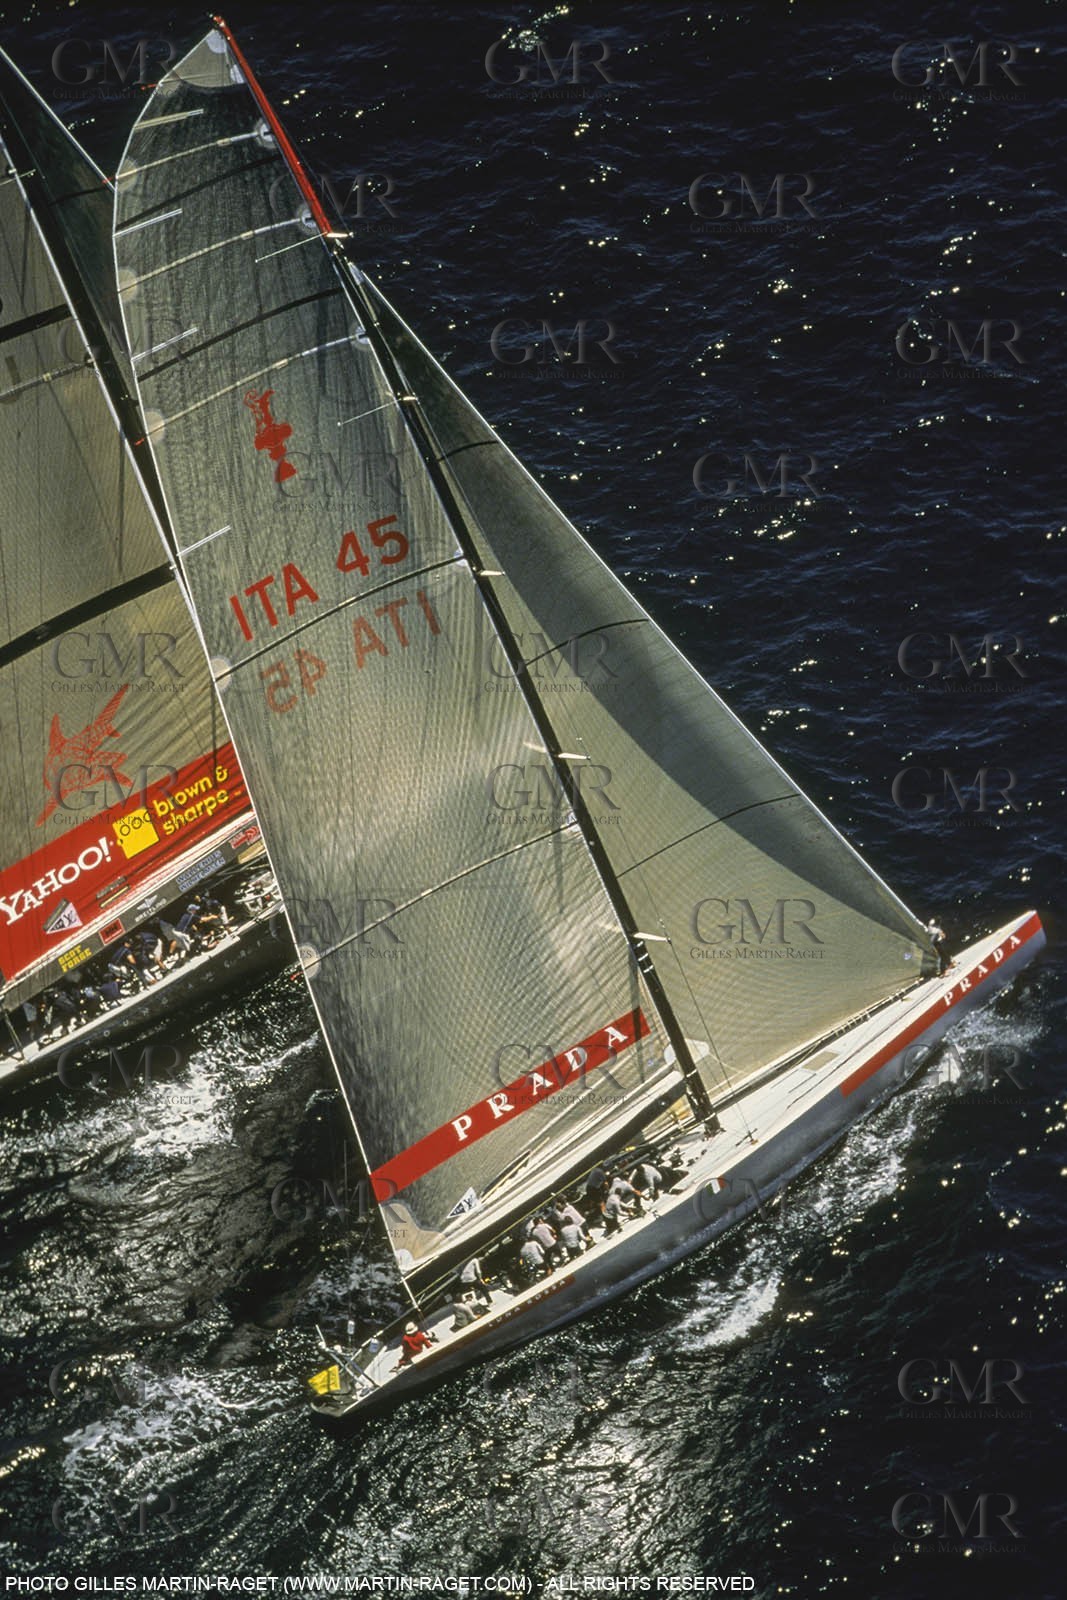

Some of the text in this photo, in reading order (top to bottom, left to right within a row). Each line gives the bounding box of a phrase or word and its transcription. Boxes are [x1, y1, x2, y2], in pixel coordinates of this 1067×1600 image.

[230, 515, 409, 641] ITA 45
[153, 766, 228, 817] brown &
[163, 790, 229, 835] sharpe
[0, 837, 111, 926] YAHOO!
[944, 935, 1021, 1006] PRADA
[451, 1026, 629, 1142] PRADA
